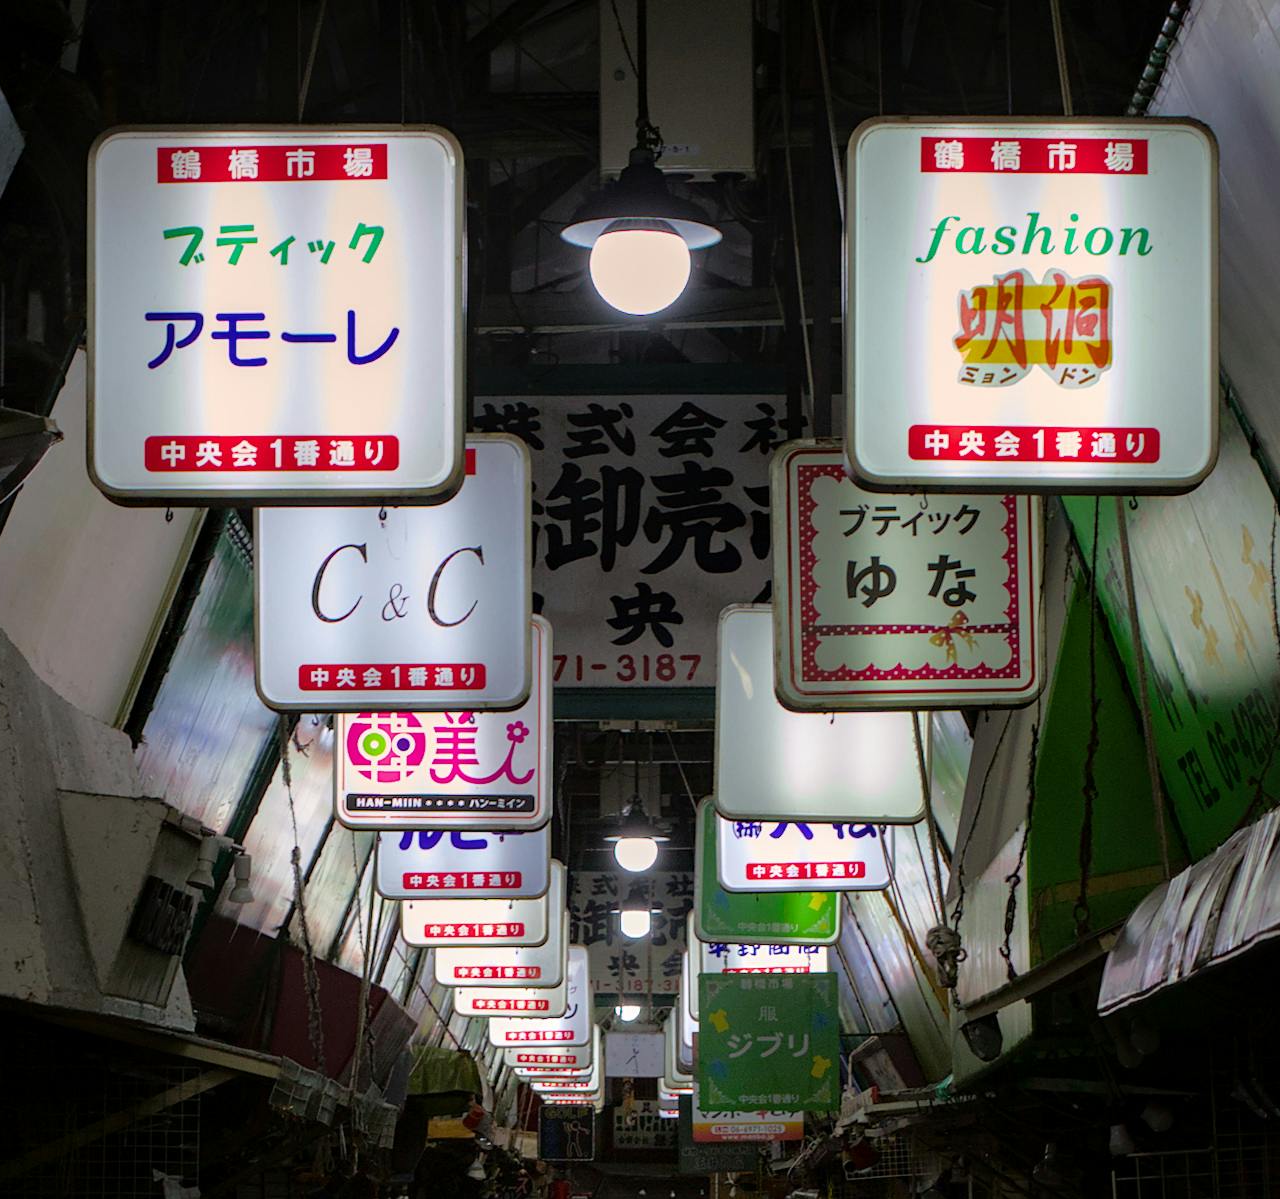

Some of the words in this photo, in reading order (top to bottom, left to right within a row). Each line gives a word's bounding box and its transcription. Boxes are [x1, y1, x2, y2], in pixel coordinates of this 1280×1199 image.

[170, 147, 374, 180] 鶴橋市場
[933, 139, 1135, 172] 鶴橋市場
[163, 222, 385, 268] ブティック
[915, 212, 1153, 264] fashion
[953, 269, 1113, 370] 明洞
[144, 309, 400, 370] アモーレ
[160, 438, 386, 471] 中央会1番通り
[923, 427, 1148, 461] 中央会1番通り
[532, 460, 770, 574] 卸売
[839, 503, 981, 538] ブティック
[311, 543, 368, 624] C
[381, 583, 410, 622] &
[427, 545, 486, 627] C
[846, 553, 977, 608] ゆな
[310, 665, 477, 688] 中央会1番通り
[356, 797, 422, 808] HAN-MIIN
[409, 873, 517, 888] 中央会1番通り
[752, 863, 859, 877] 中央会1番通り
[429, 924, 521, 937] 中央会1番通り
[458, 967, 538, 979] 中央会1番通り
[758, 1006, 778, 1022] 服
[727, 1031, 810, 1059] ジブリ
